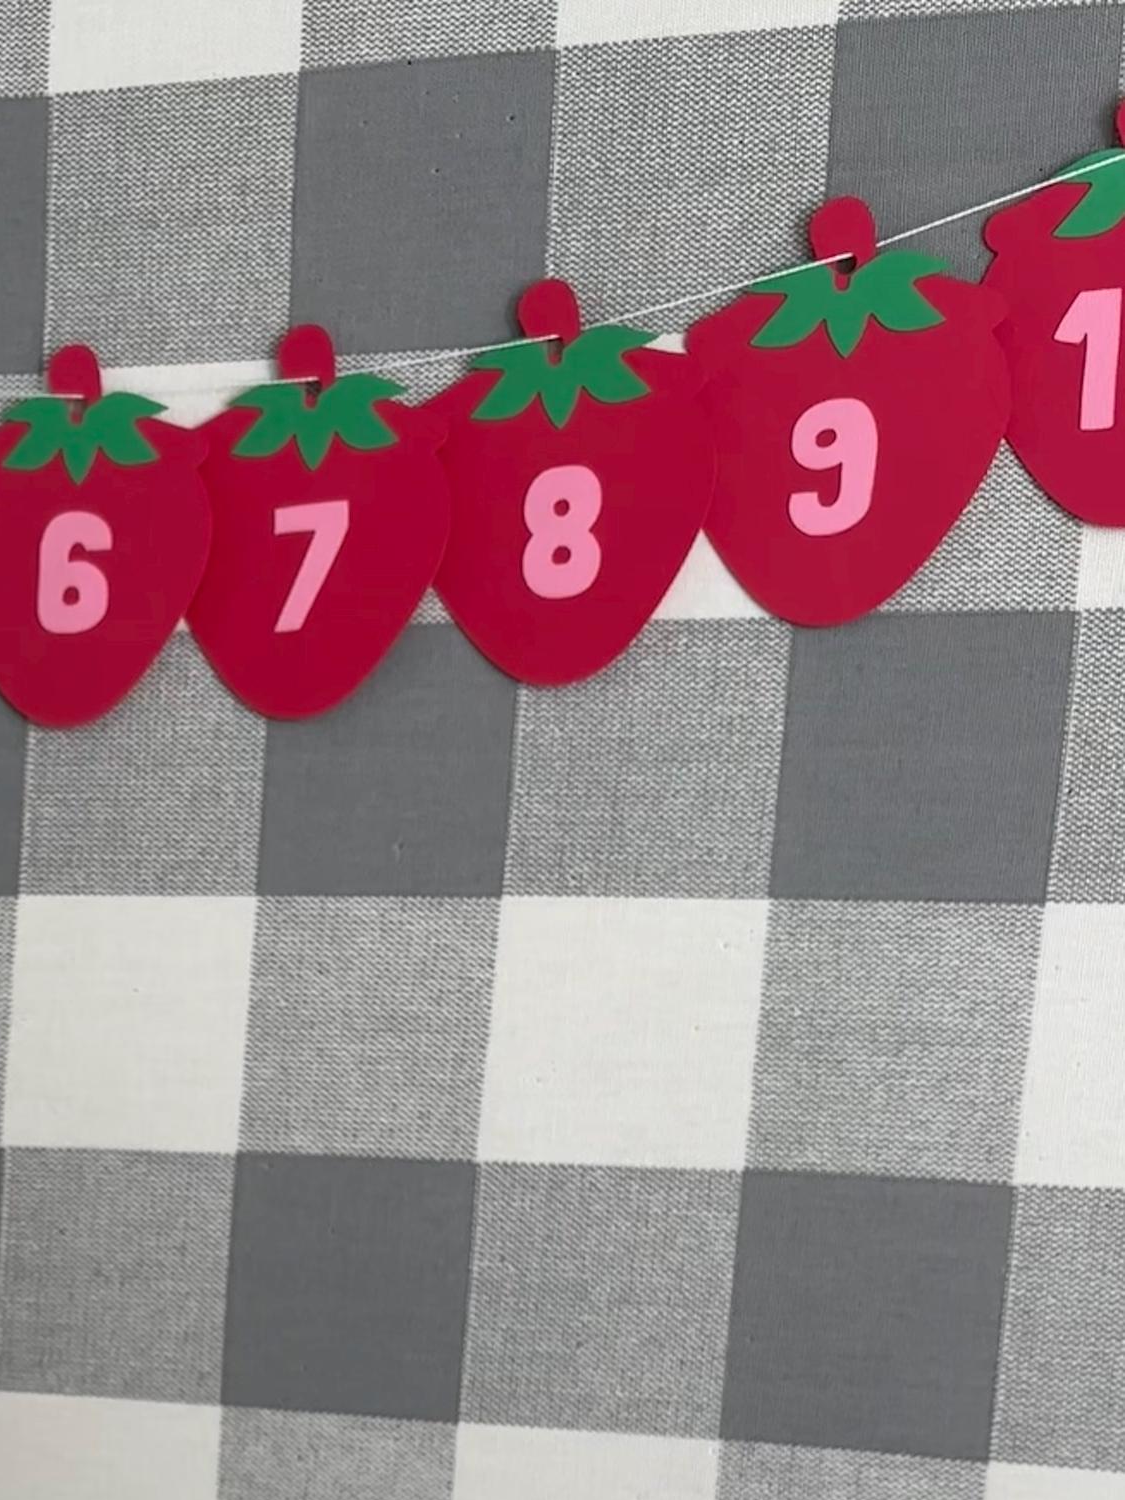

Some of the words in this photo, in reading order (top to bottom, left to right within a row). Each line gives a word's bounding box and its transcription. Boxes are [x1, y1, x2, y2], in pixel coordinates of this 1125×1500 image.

[521, 465, 602, 599] 8
[788, 398, 879, 537] 9
[37, 511, 112, 634] 6
[273, 500, 349, 633] 7
